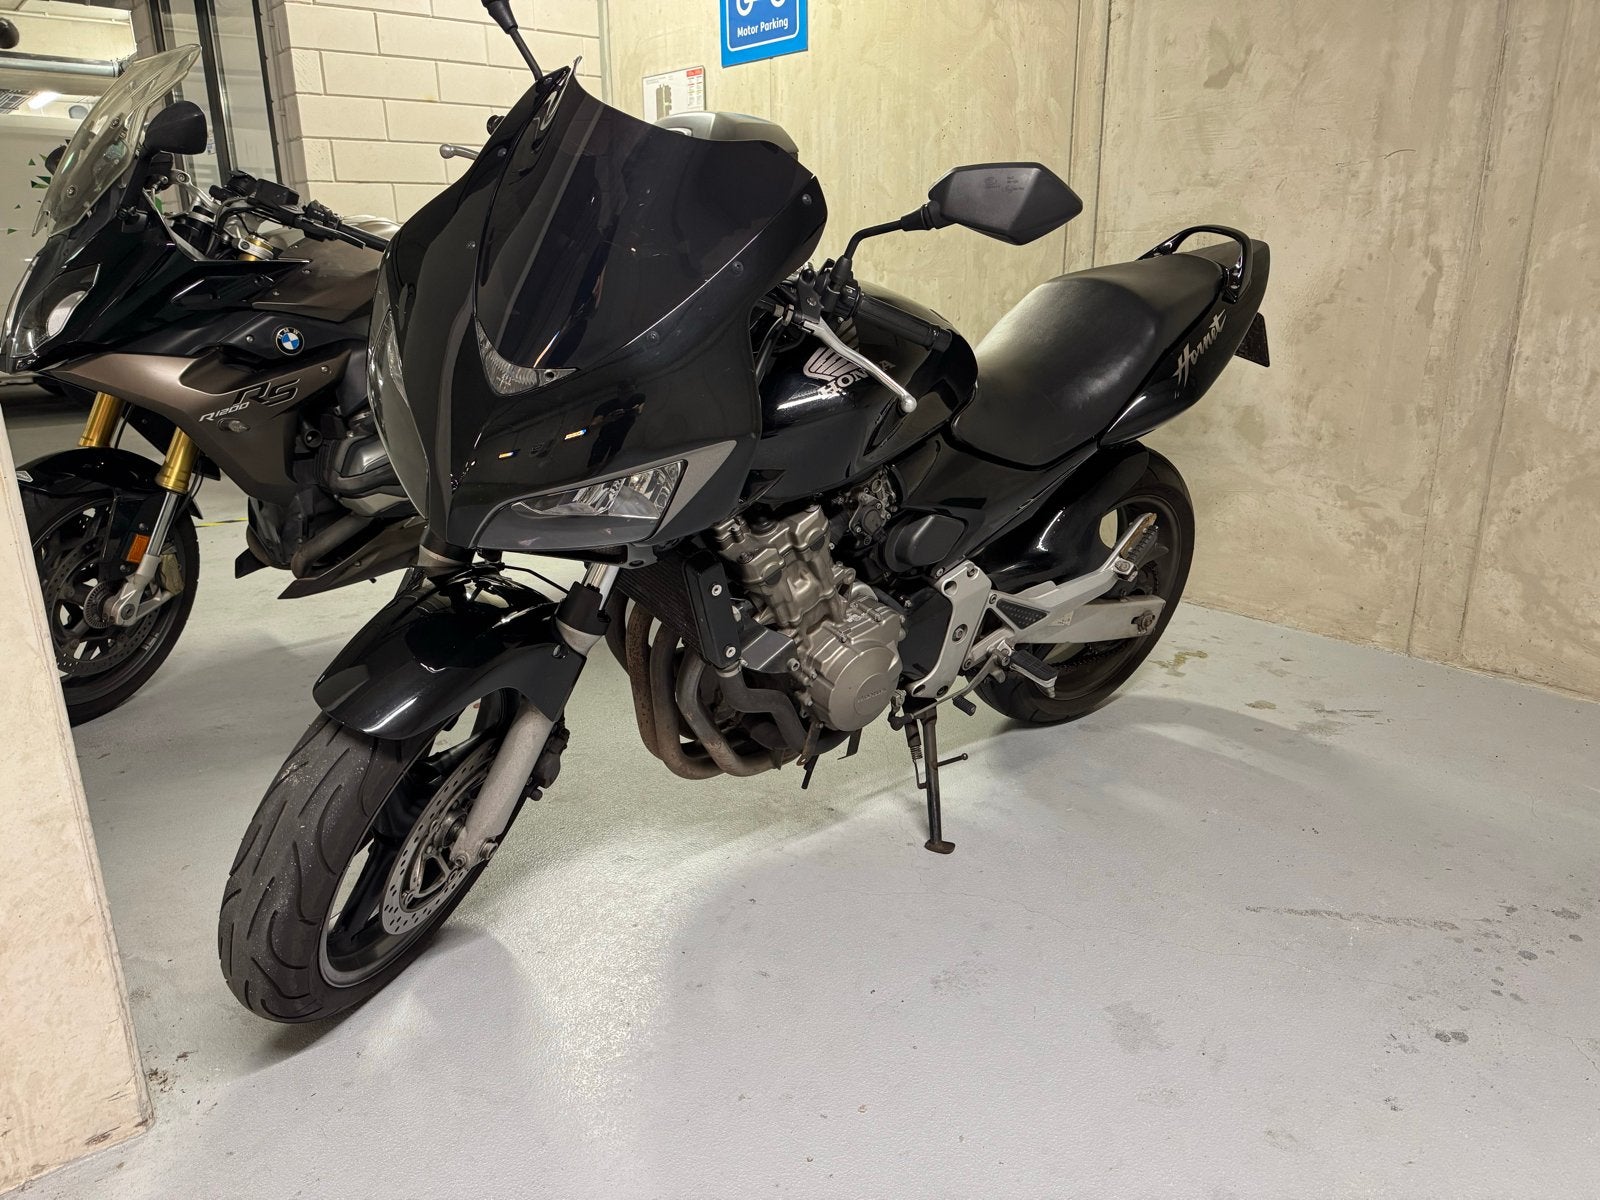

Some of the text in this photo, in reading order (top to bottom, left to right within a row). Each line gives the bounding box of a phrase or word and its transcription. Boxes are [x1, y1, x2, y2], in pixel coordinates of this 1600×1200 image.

[737, 17, 789, 38] Motor Parking
[1172, 309, 1227, 388] Hornet
[198, 378, 302, 422] R1200 RS
